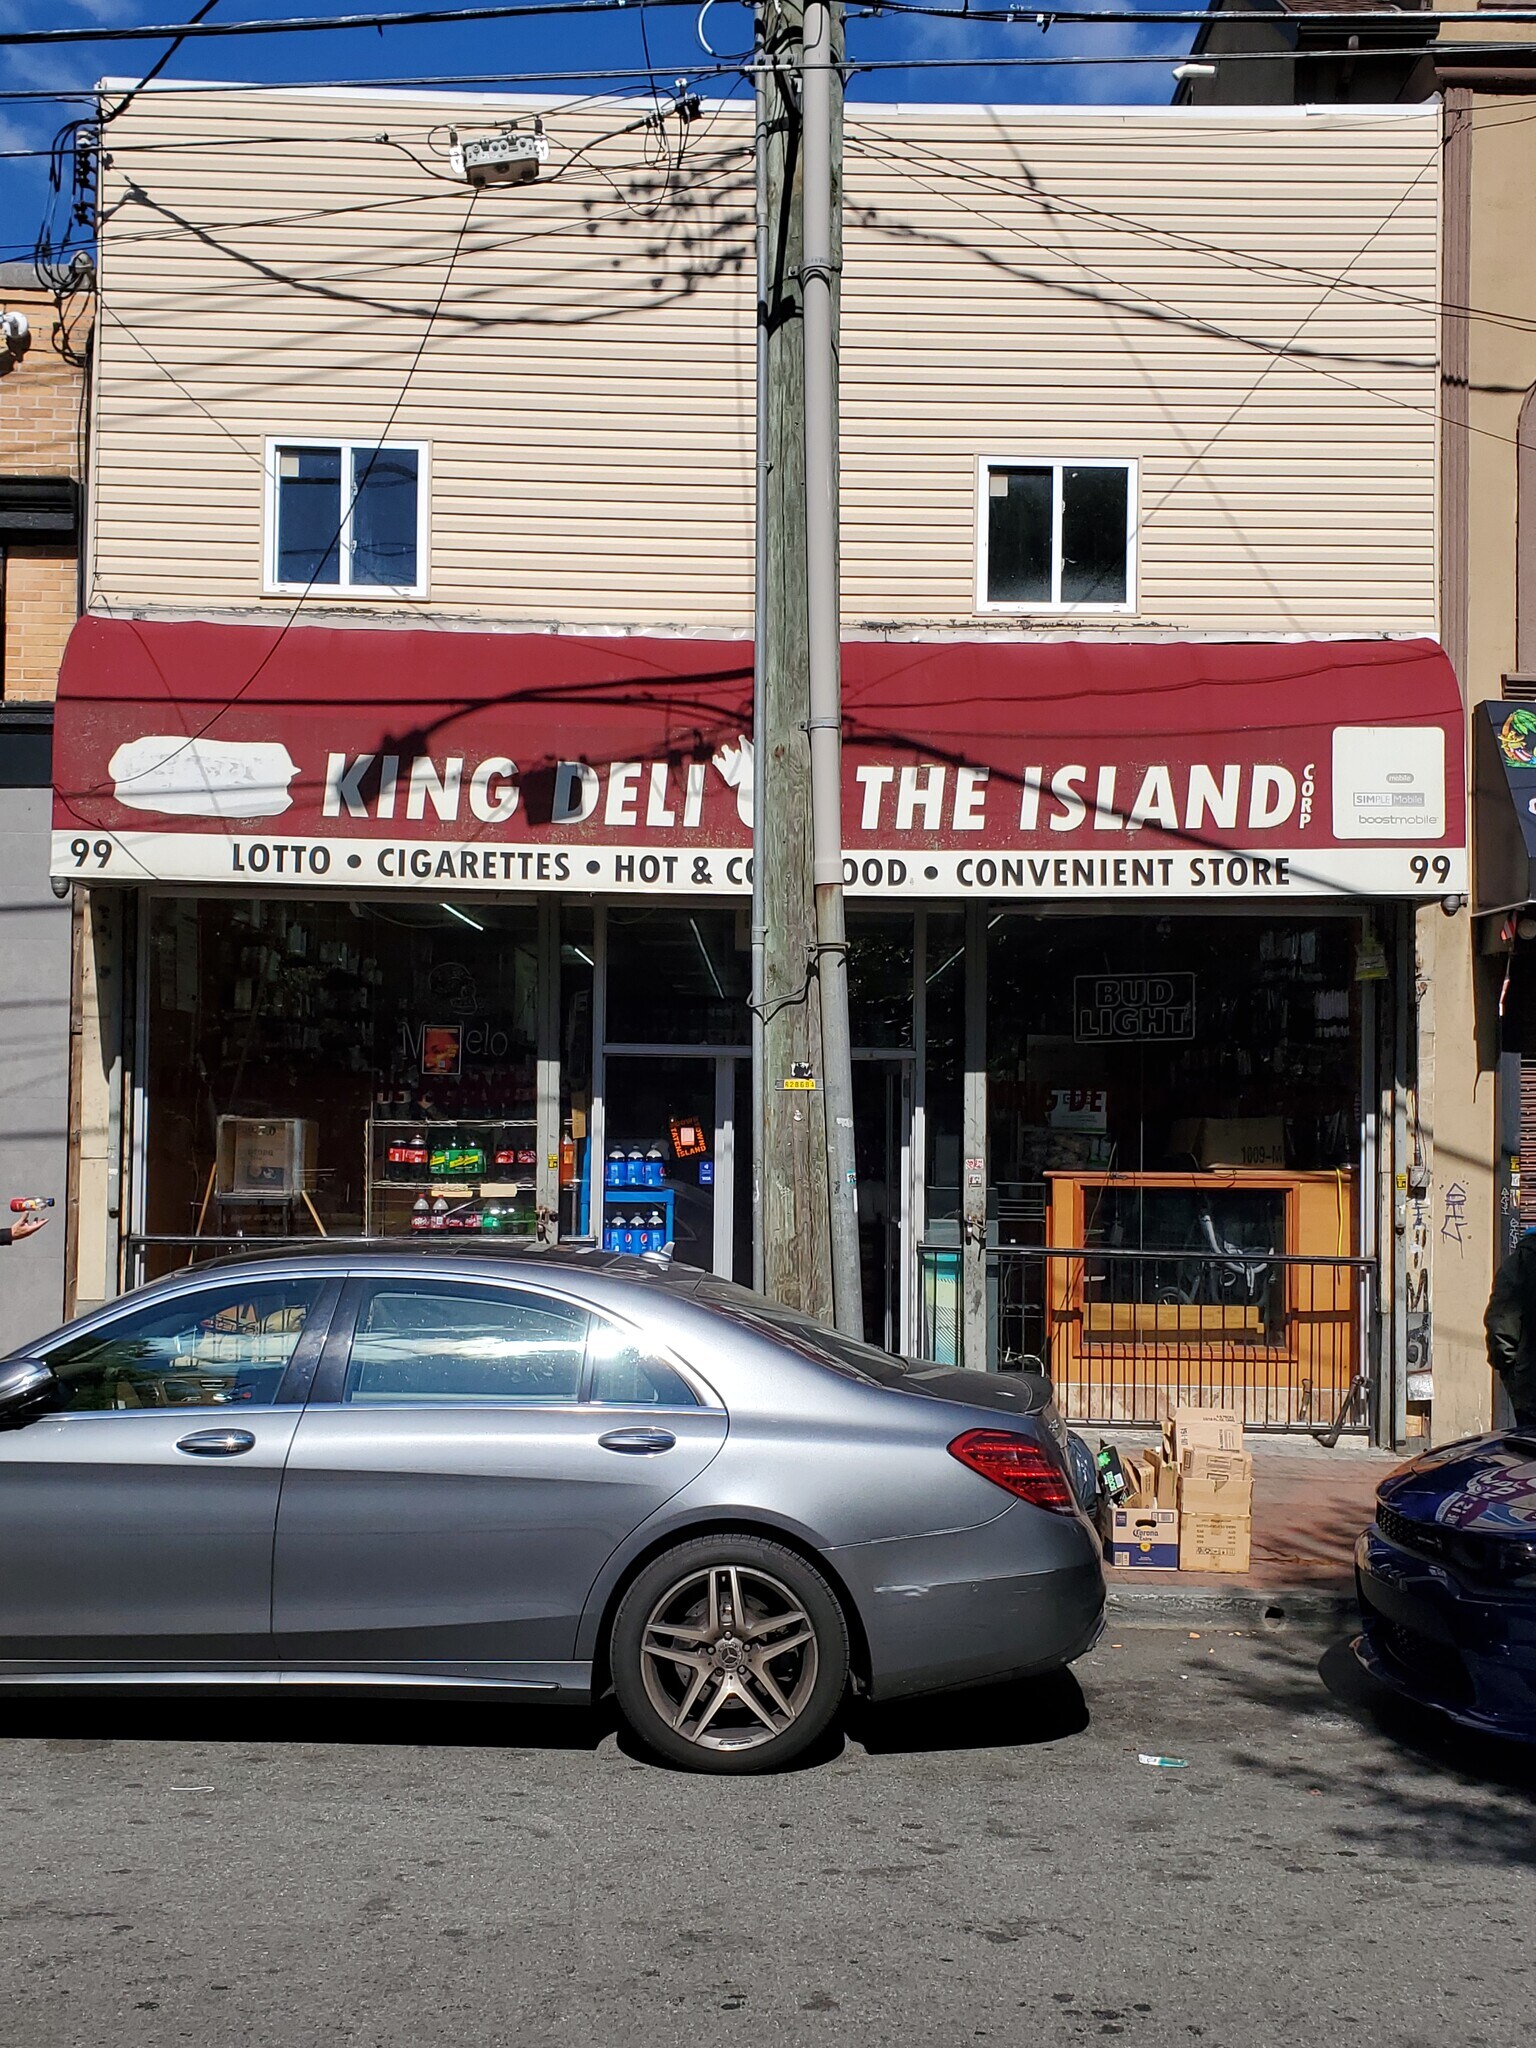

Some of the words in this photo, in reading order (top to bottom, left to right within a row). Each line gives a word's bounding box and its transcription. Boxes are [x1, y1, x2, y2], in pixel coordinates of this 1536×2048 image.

[321, 752, 520, 824] KING
[550, 759, 706, 828] DELI
[855, 765, 990, 831] THE
[1019, 763, 1297, 832] ISLAND
[1387, 774, 1411, 783] mobile
[1299, 763, 1315, 830] CORP
[1356, 795, 1391, 804] SIMPLE
[1393, 795, 1423, 804] Mobile
[1358, 814, 1438, 825] boostmobile
[70, 838, 113, 869] 99
[232, 843, 331, 875] LOTTO
[376, 847, 570, 881] CIGARETTES
[615, 854, 679, 884] HOT
[691, 856, 713, 885] &
[842, 857, 907, 887] OOD
[956, 857, 1174, 887] CONVENIENT
[1190, 856, 1290, 887] STORE
[1409, 855, 1451, 884] 99
[1095, 979, 1174, 1008] BUD
[1080, 1007, 1190, 1036] LIGHT
[1132, 1529, 1159, 1537] Corona
